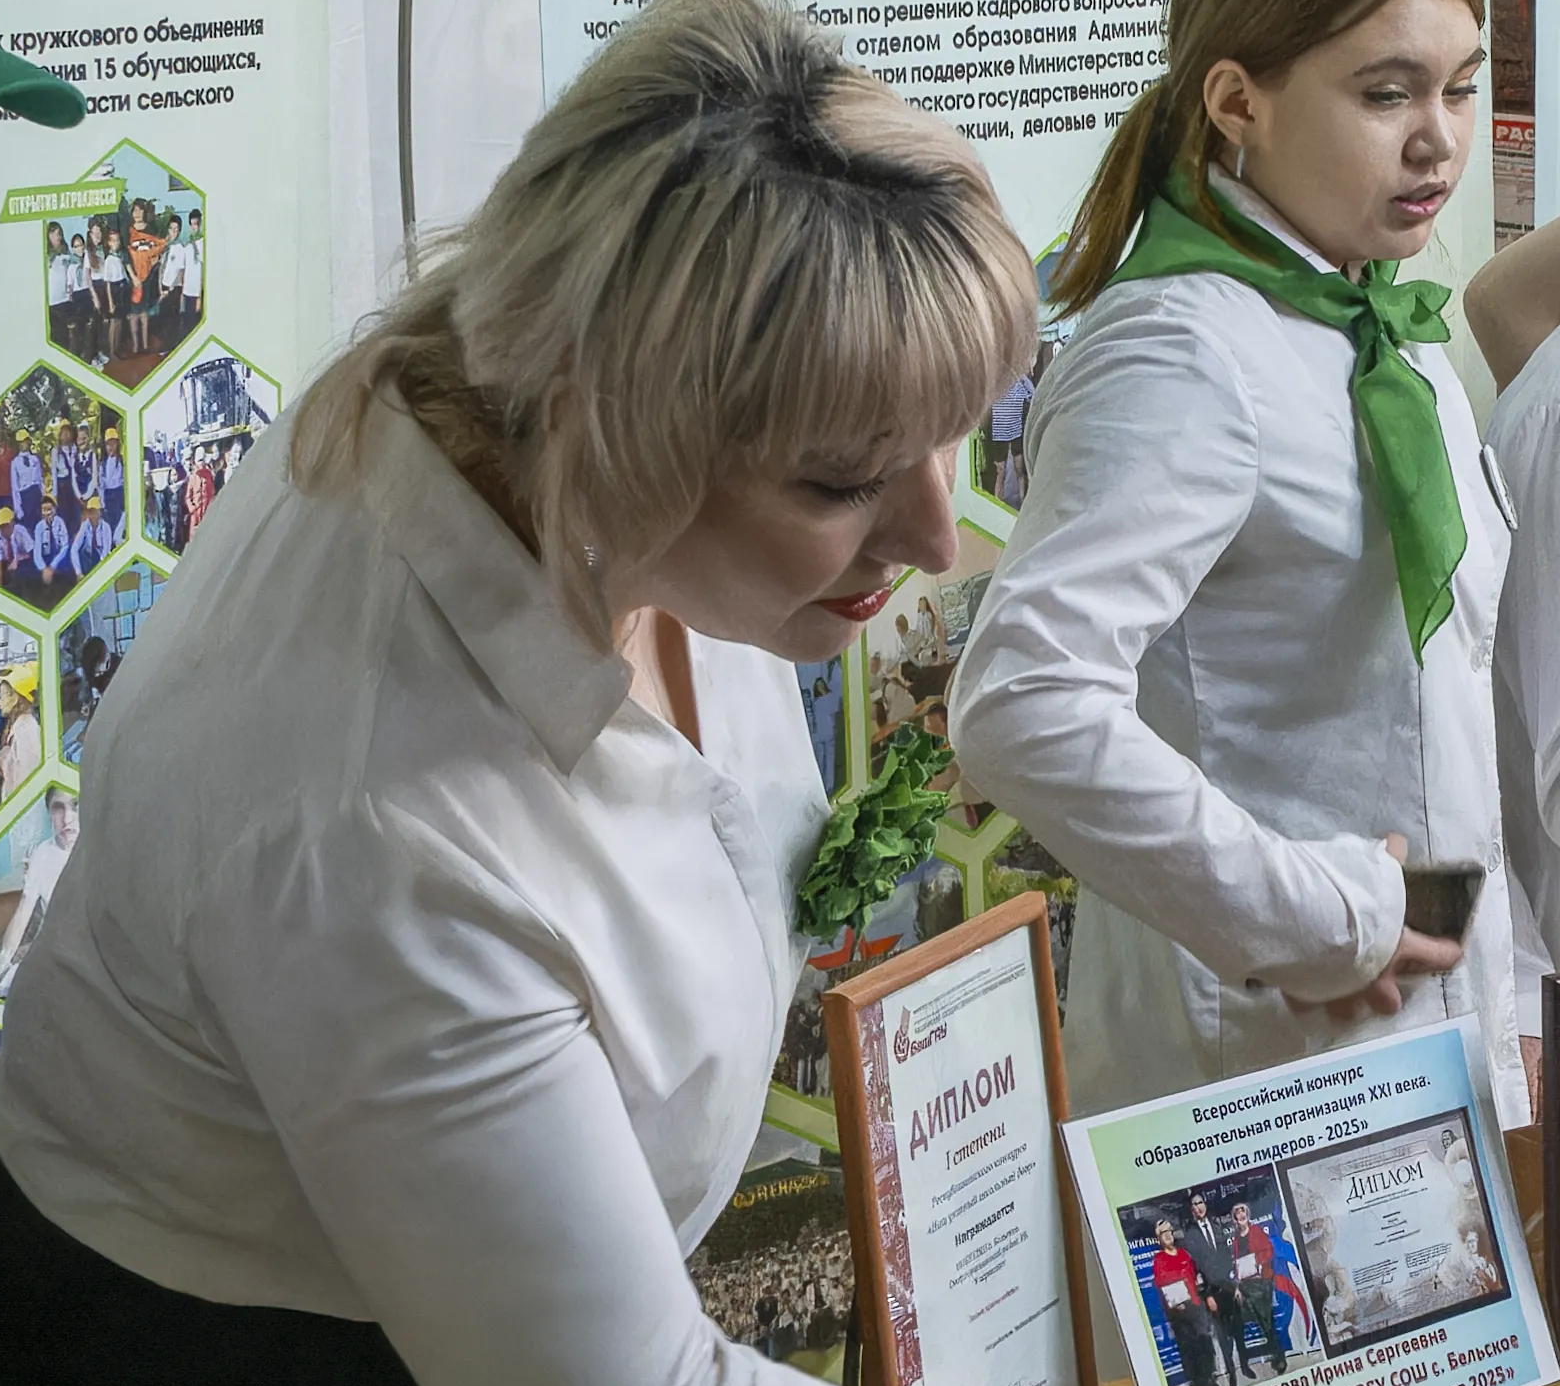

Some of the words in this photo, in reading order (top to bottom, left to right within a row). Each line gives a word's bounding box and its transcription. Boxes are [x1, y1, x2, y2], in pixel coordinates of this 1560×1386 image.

[10, 24, 138, 55] кружкового
[144, 17, 265, 44] объединения
[856, 32, 941, 56] отделом
[952, 22, 1077, 51] образования
[93, 57, 117, 80] 15
[123, 50, 262, 79] обучающихся,
[871, 64, 907, 86] при
[911, 56, 1015, 85] поддержке
[1018, 46, 1144, 77] Министерства
[138, 85, 235, 112] сельского
[977, 79, 1139, 111] государственного
[1022, 112, 1097, 138] деловые
[909, 1054, 1016, 1161] ДИПЛОМ
[1192, 1077, 1304, 1123] Всероссийский
[1306, 1063, 1365, 1099] конкурс
[1134, 1117, 1272, 1169] «Образовательная
[1274, 1094, 1366, 1137] организация
[1369, 1080, 1393, 1103] XXI
[1395, 1073, 1431, 1098] века.
[953, 1122, 1007, 1165] степени
[1215, 1150, 1250, 1176] Лига
[1253, 1134, 1316, 1167] лидеров
[1325, 1118, 1370, 1143] 2025»
[1346, 1161, 1425, 1205] ДИПЛОМ
[1312, 1353, 1364, 1386] Ирина
[1366, 1326, 1448, 1369] Сергеевна
[1447, 1332, 1520, 1376] Бельское
